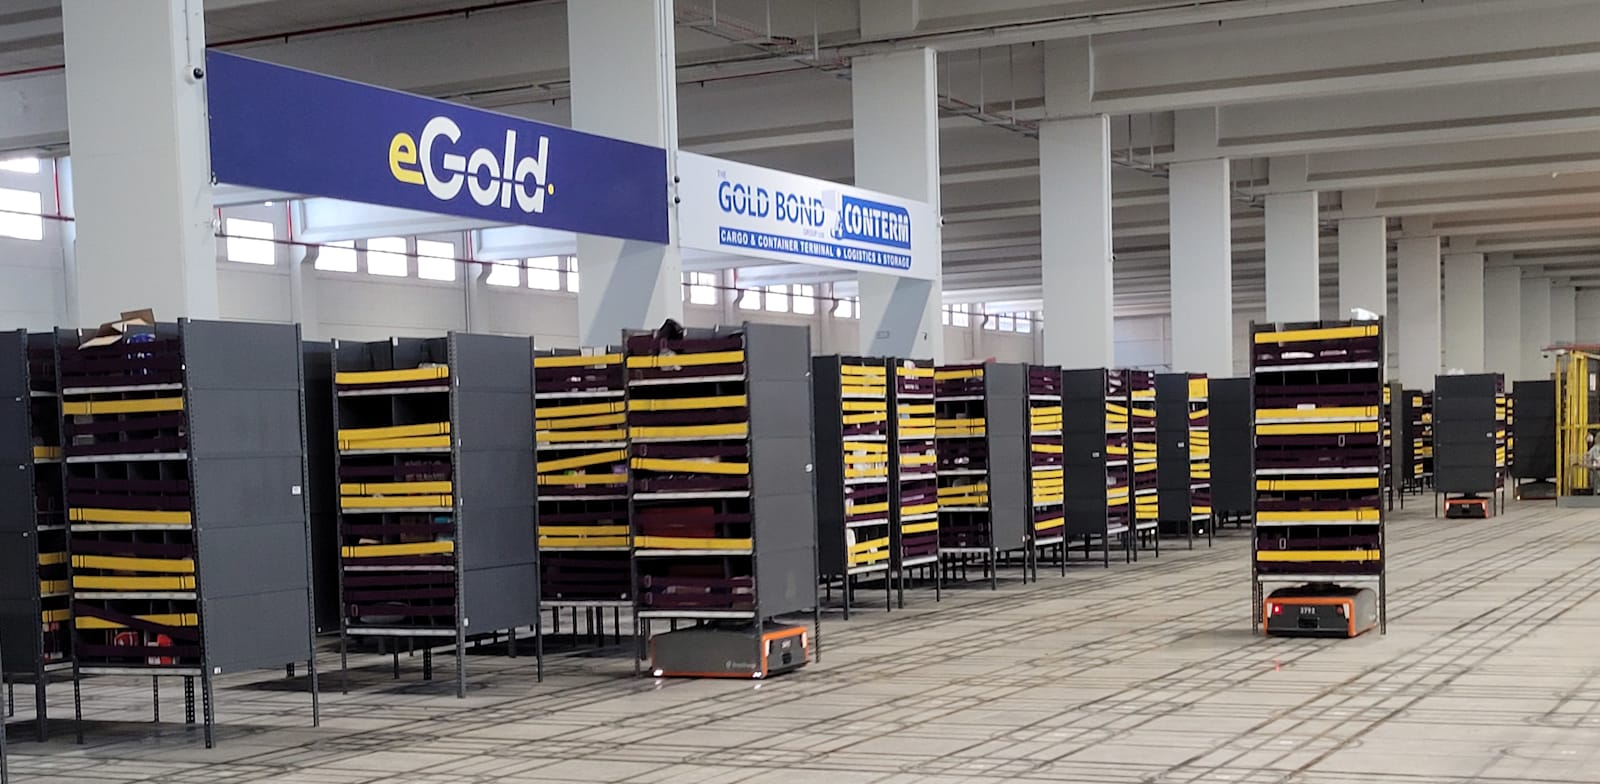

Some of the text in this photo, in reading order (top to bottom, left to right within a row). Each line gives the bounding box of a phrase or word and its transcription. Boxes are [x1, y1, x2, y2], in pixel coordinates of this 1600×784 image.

[718, 181, 825, 227] GOLD BOND
[844, 202, 909, 243] CONTERM
[721, 230, 910, 268] CARGO & CONTAINER TERMINAL LOGISTICS & STORAGE
